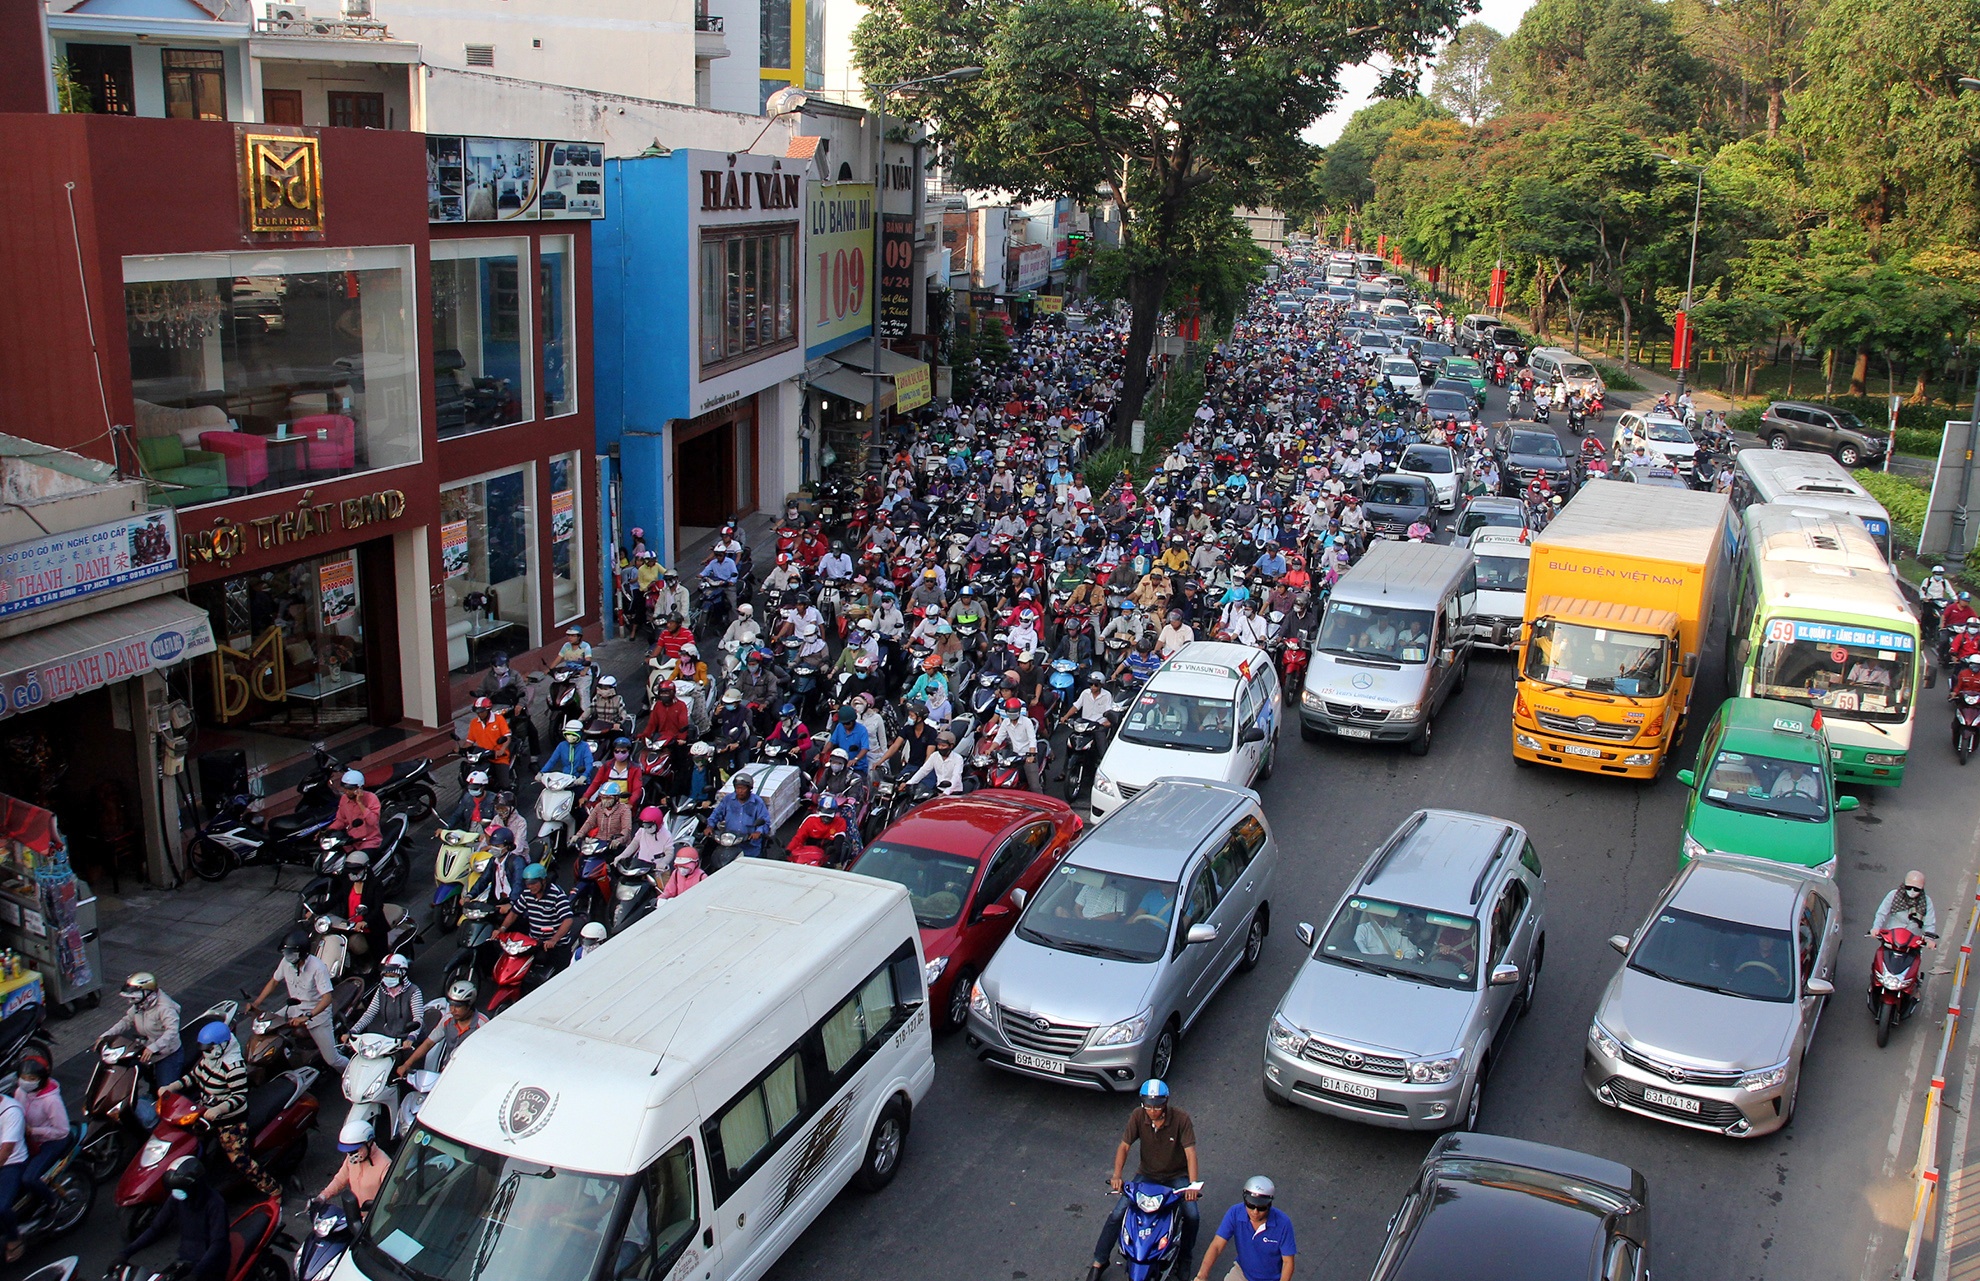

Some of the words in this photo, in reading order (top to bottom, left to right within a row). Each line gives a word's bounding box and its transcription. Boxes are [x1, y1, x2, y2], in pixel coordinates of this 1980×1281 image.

[701, 153, 752, 211] HẢI
[755, 159, 800, 210] VÂN
[813, 191, 826, 235] LÒ
[829, 191, 856, 233] BÁNH
[859, 191, 871, 230] MÌ
[886, 220, 904, 233] BÁNH
[885, 240, 912, 269] 09
[817, 247, 865, 327] 109
[882, 276, 910, 288] 4/24
[92, 531, 109, 543] CAO
[184, 517, 247, 568] NỘI
[250, 489, 336, 549] THẤT
[340, 490, 406, 530] BMD
[17, 568, 63, 598] THANH
[75, 556, 111, 583] DANH
[1549, 561, 1578, 572] BƯU
[1582, 566, 1615, 578] ĐIỆN
[1620, 570, 1649, 582] VIỆT
[1652, 575, 1683, 586] NAM
[1772, 621, 1794, 641] 59
[13, 670, 43, 708] GỖ
[45, 655, 103, 699] THANH
[104, 641, 150, 680] DANH
[1185, 664, 1213, 673] VINASUN
[1534, 703, 1560, 713] HINO
[1839, 695, 1854, 711] 59
